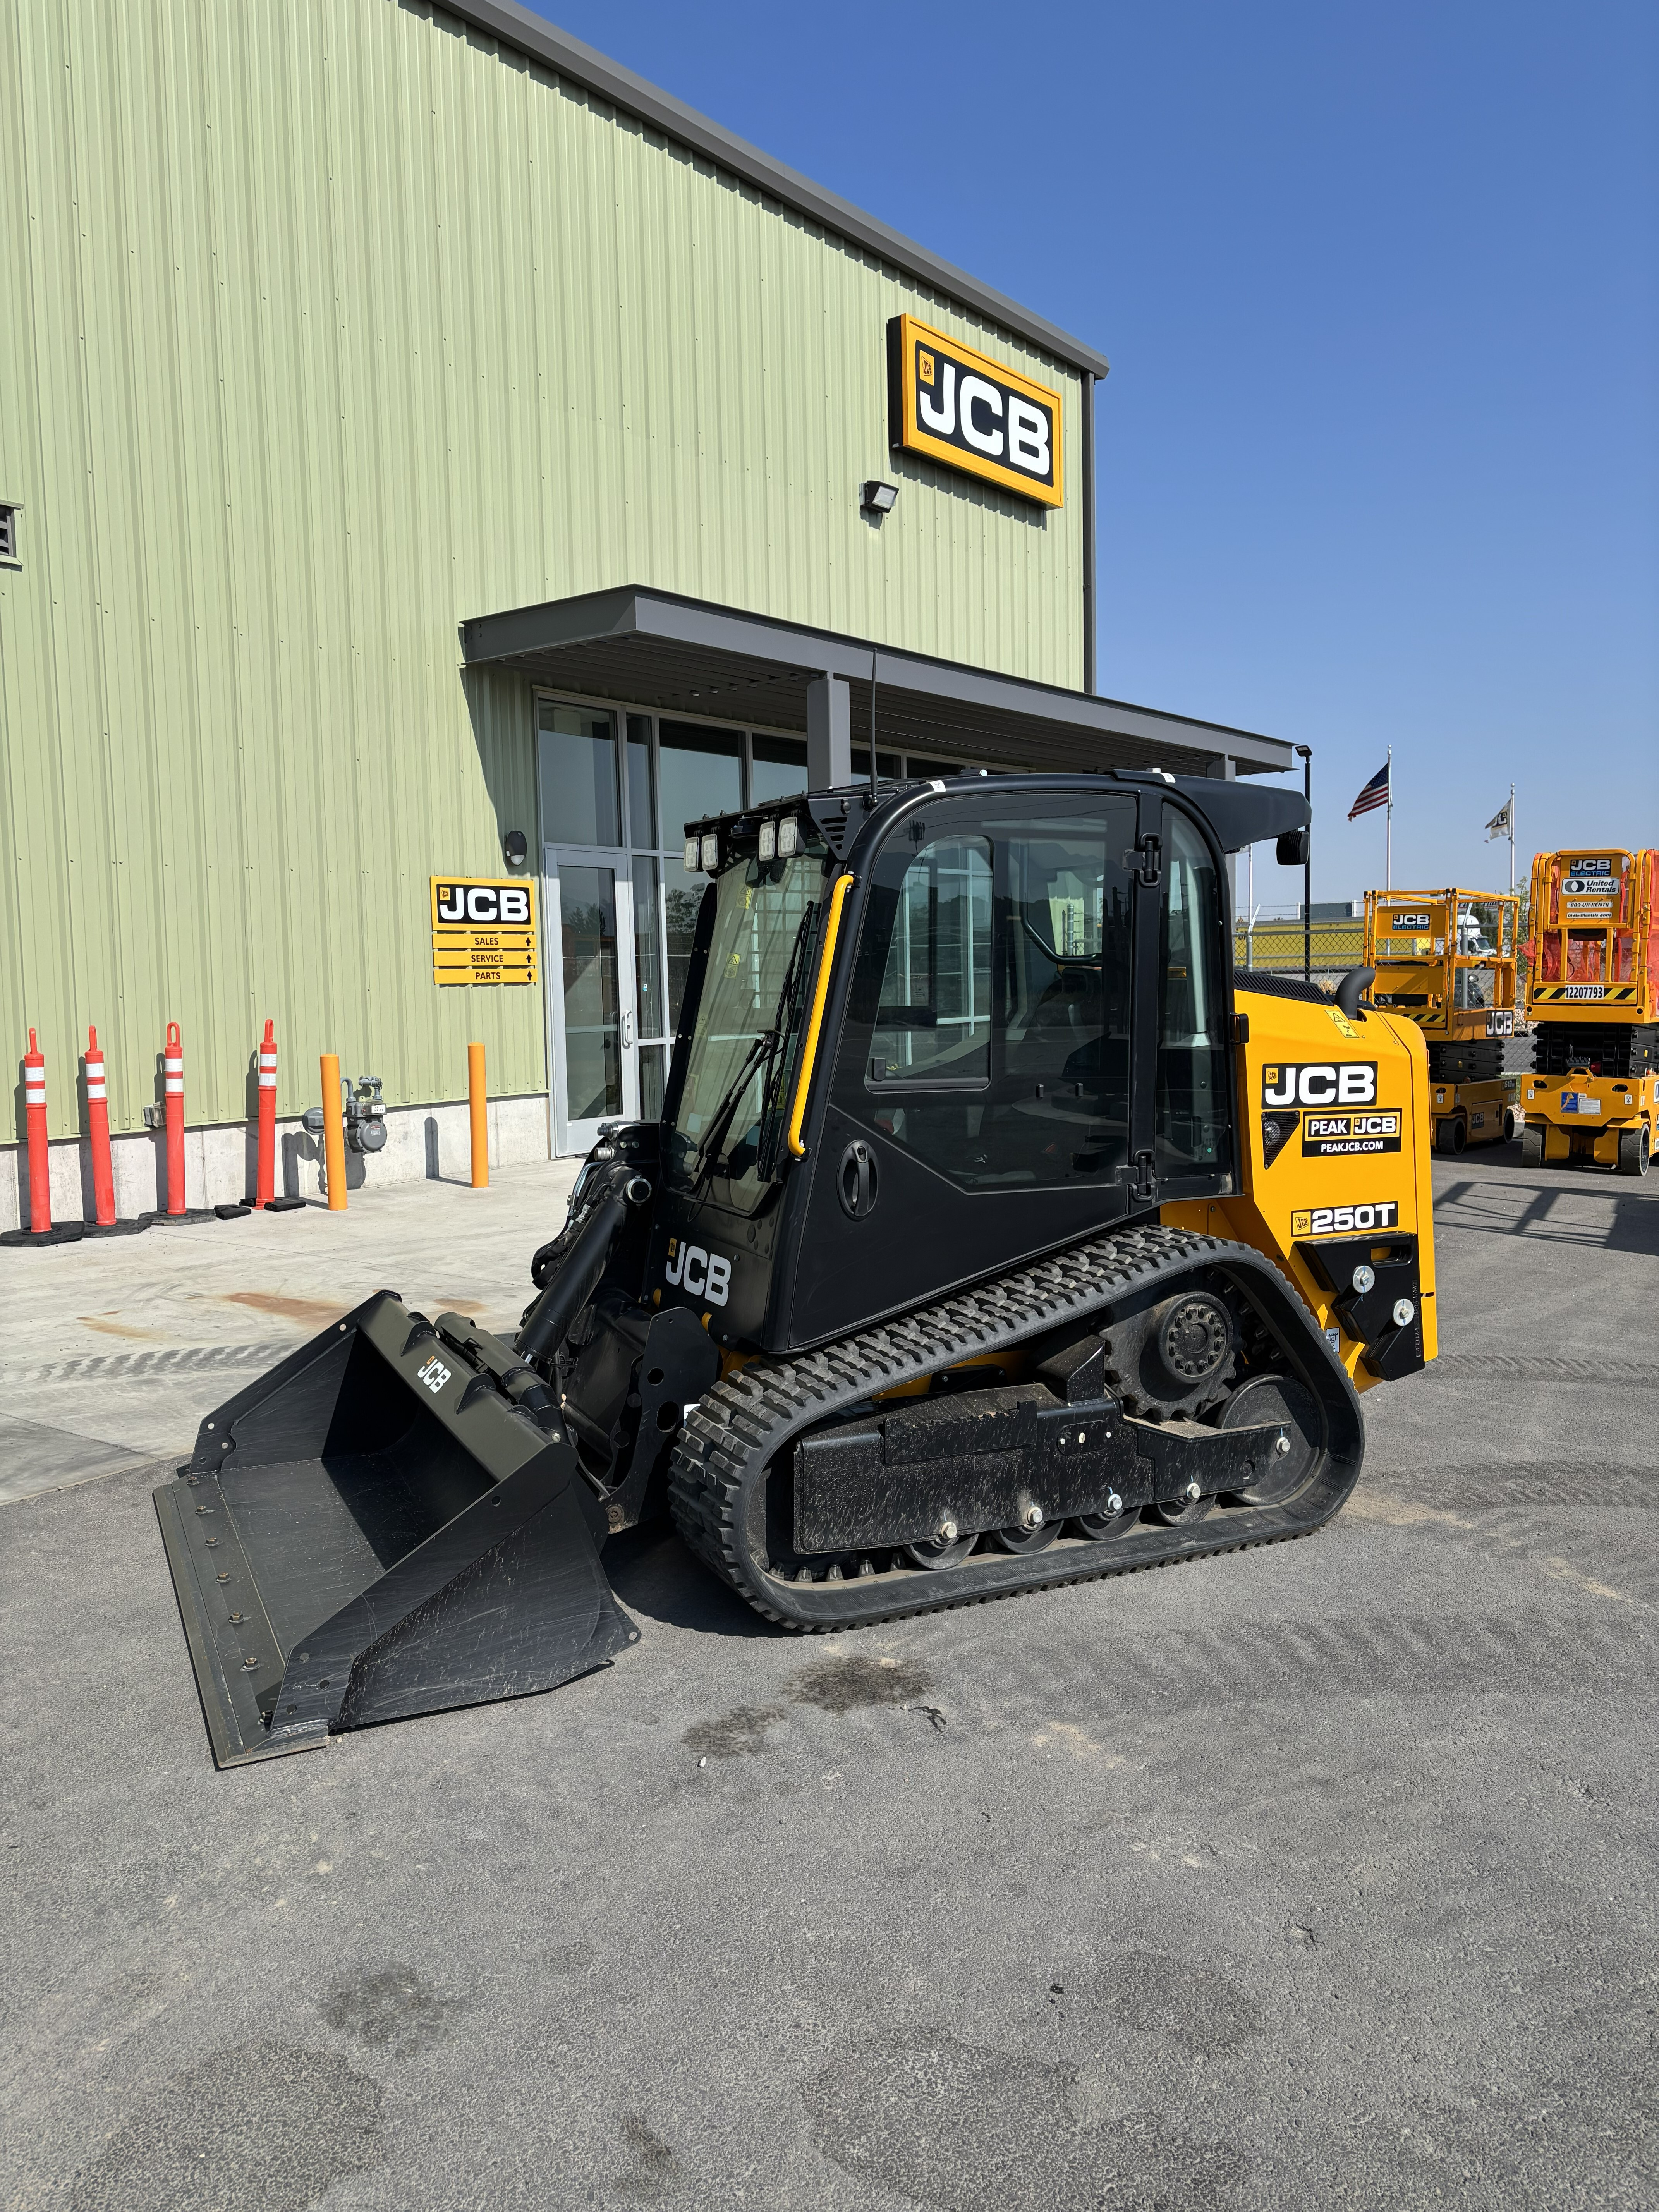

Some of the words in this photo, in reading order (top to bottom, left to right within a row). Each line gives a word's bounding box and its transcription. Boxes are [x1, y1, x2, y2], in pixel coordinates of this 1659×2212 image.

[920, 363, 1050, 475] JCB
[1571, 860, 1610, 870] JCB
[440, 888, 528, 921] JCB
[1393, 915, 1429, 925] JCB
[1566, 987, 1602, 998] 12207793
[1486, 1012, 1513, 1035] JCB
[1265, 1066, 1374, 1105] JCB
[1311, 1120, 1348, 1135] PEAK
[1354, 1117, 1396, 1134] JCB
[1472, 1113, 1484, 1124] JCB
[1321, 1141, 1383, 1152] PEAKJCB.COM
[1298, 1218, 1308, 1228] JCB
[1312, 1203, 1395, 1233] 250T
[666, 1242, 731, 1307] JCB
[417, 1358, 452, 1393] JCB
